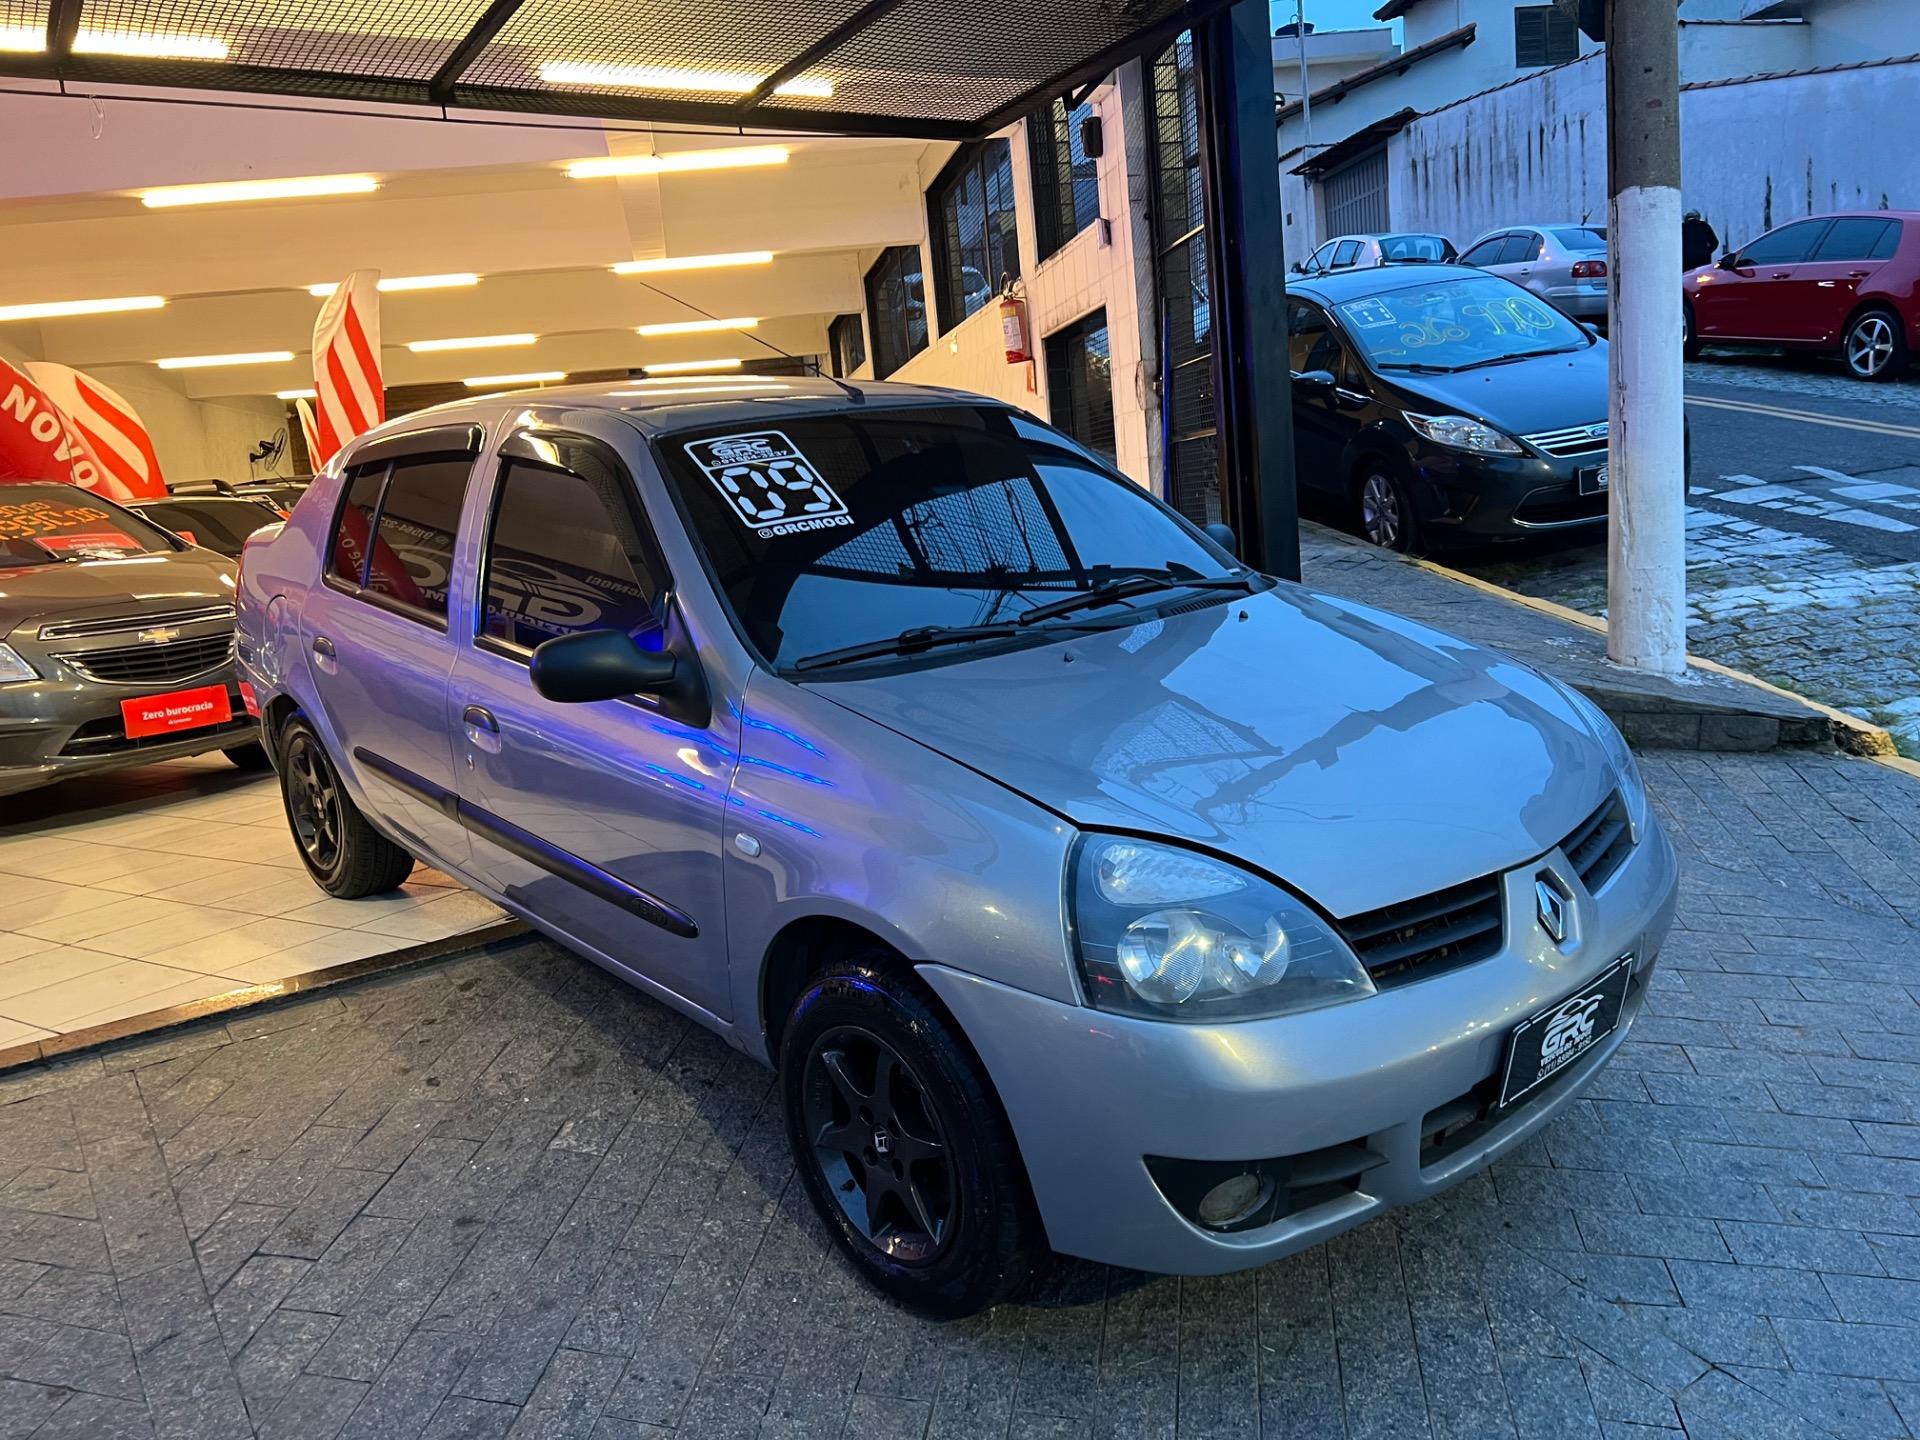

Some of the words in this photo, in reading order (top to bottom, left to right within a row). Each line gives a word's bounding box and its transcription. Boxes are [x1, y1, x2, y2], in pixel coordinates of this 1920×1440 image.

[0, 383, 99, 488] NOVO
[720, 460, 832, 520] 09
[142, 710, 165, 721] Zero
[165, 701, 214, 717] burocracia
[1541, 1001, 1599, 1057] GRC
